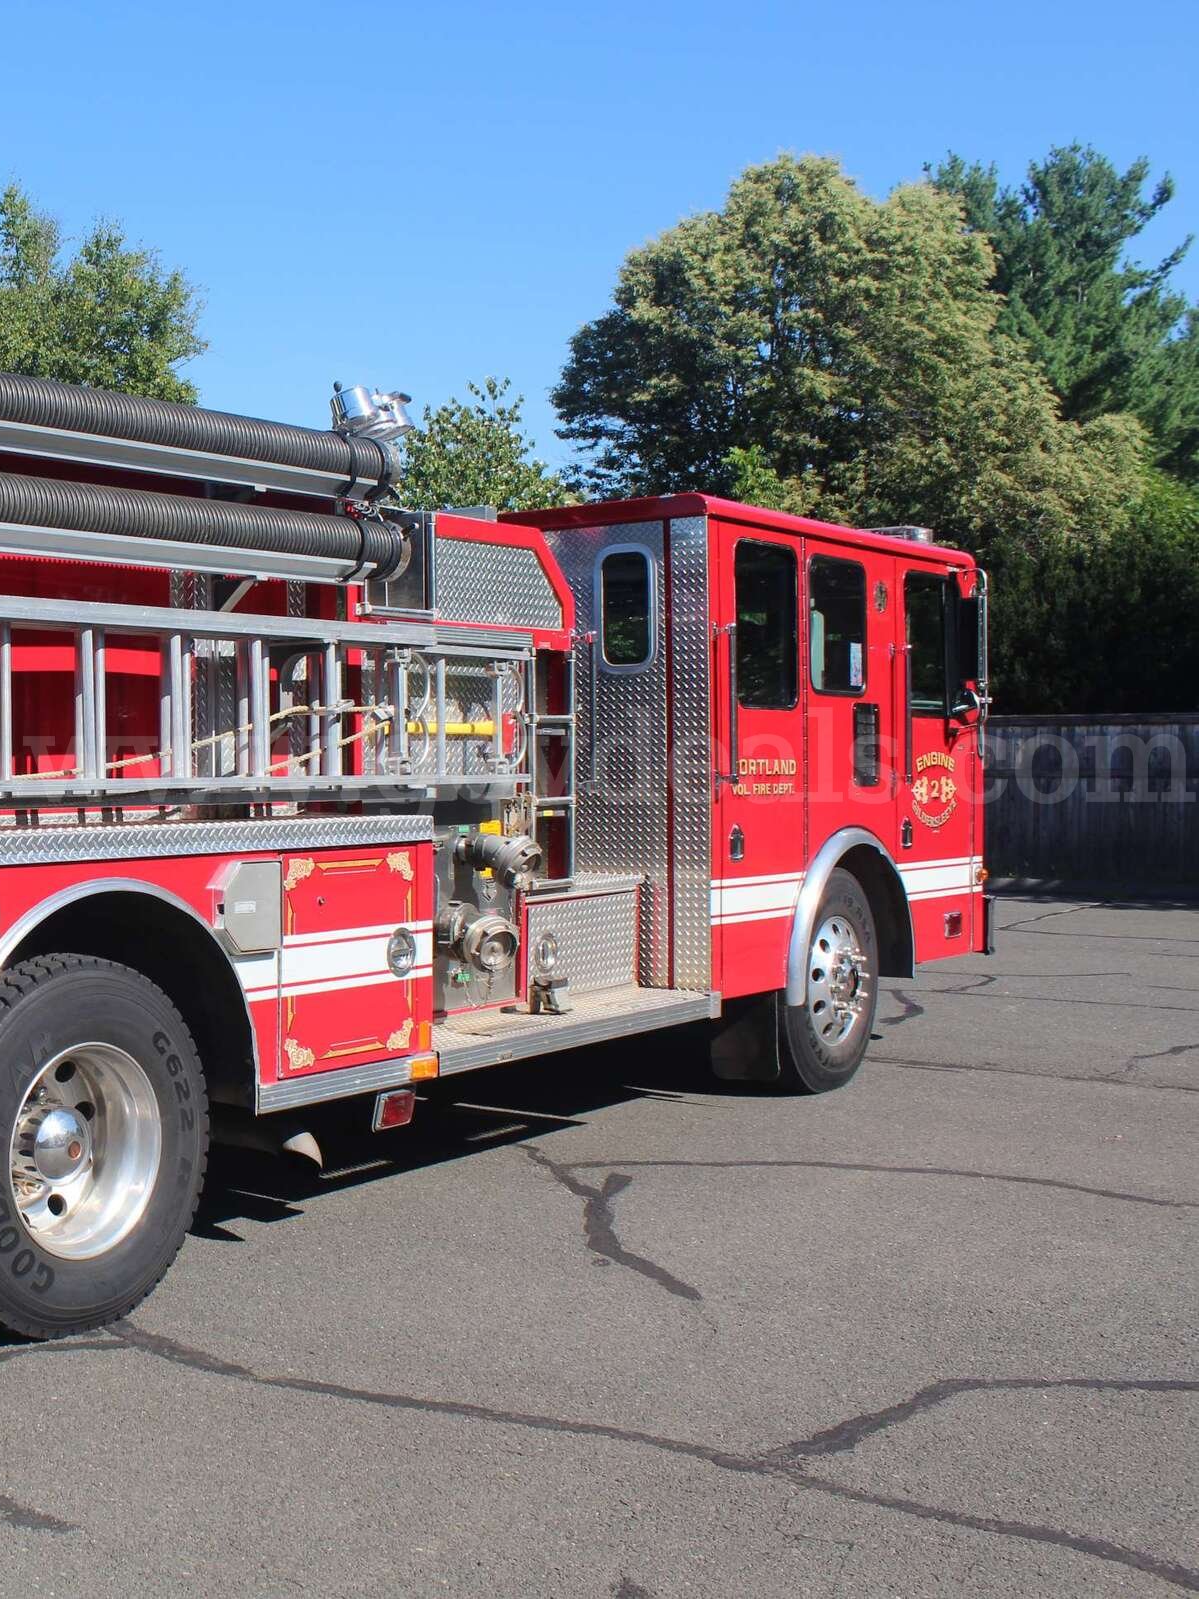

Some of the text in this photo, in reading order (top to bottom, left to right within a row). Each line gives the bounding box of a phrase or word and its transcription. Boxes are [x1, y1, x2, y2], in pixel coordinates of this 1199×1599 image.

[736, 759, 797, 776] ORTLAND
[915, 751, 956, 773] ENGINE
[753, 783, 772, 796] FIRE
[930, 779, 940, 799] 2
[152, 1031, 195, 1132] G622
